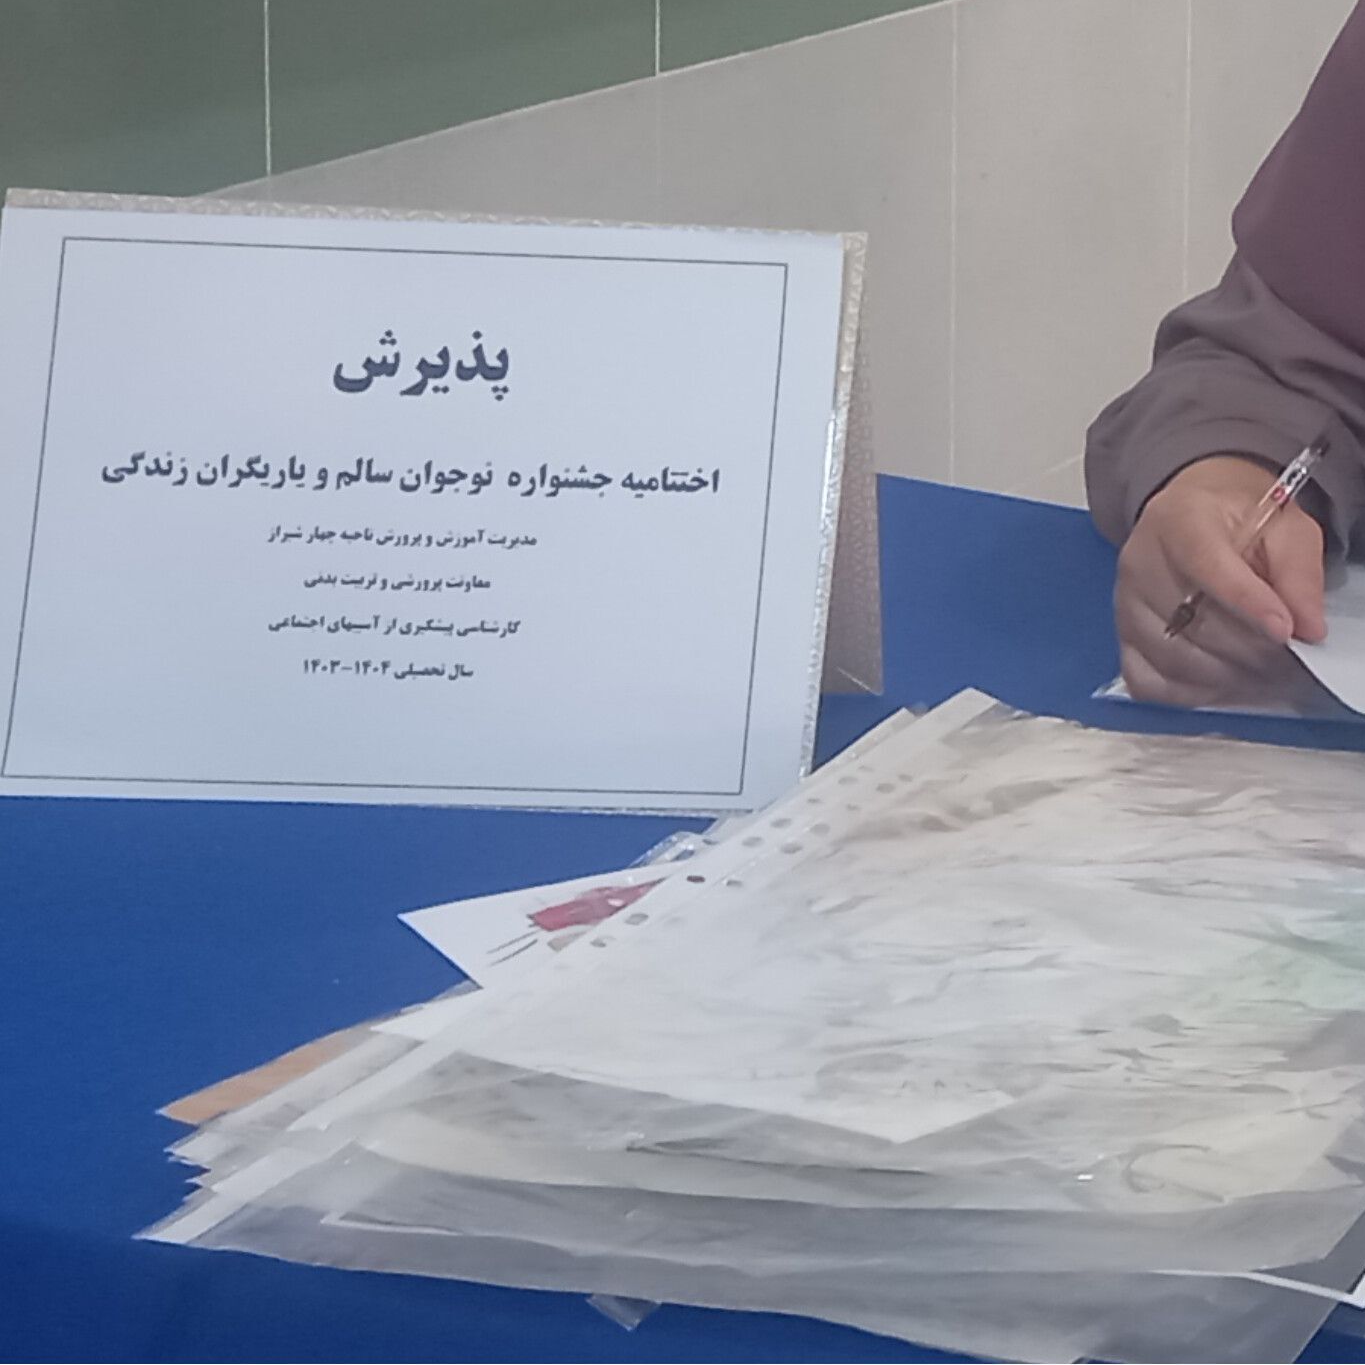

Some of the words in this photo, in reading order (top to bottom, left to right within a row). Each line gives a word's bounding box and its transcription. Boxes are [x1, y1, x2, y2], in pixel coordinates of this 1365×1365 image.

[333, 329, 510, 402] پذیرش
[101, 451, 188, 486] زندگی
[195, 454, 306, 490] یاریگران
[335, 457, 393, 491] سالم
[399, 460, 494, 496] نوجوان
[312, 466, 329, 491] و
[507, 463, 613, 498] جشنواره
[620, 466, 720, 499] اختتامیه
[267, 525, 303, 544] شیراز
[306, 525, 337, 544] چهار
[340, 527, 374, 544] ناحیه
[376, 529, 422, 547] پرورش
[424, 534, 433, 548] و
[435, 528, 485, 549] آموزش
[487, 534, 537, 550] مدیریت
[303, 572, 338, 588] بدنی
[340, 572, 378, 591] تربیت
[380, 578, 388, 591] و
[390, 573, 443, 593] پرورشی
[445, 575, 491, 593] معاونت
[268, 614, 325, 633] اجتماعی
[382, 617, 398, 635] از
[398, 618, 454, 637] پیشگیری
[456, 620, 521, 639] کارشناسی
[393, 662, 446, 680] تحصیلی
[448, 663, 474, 681] سال
